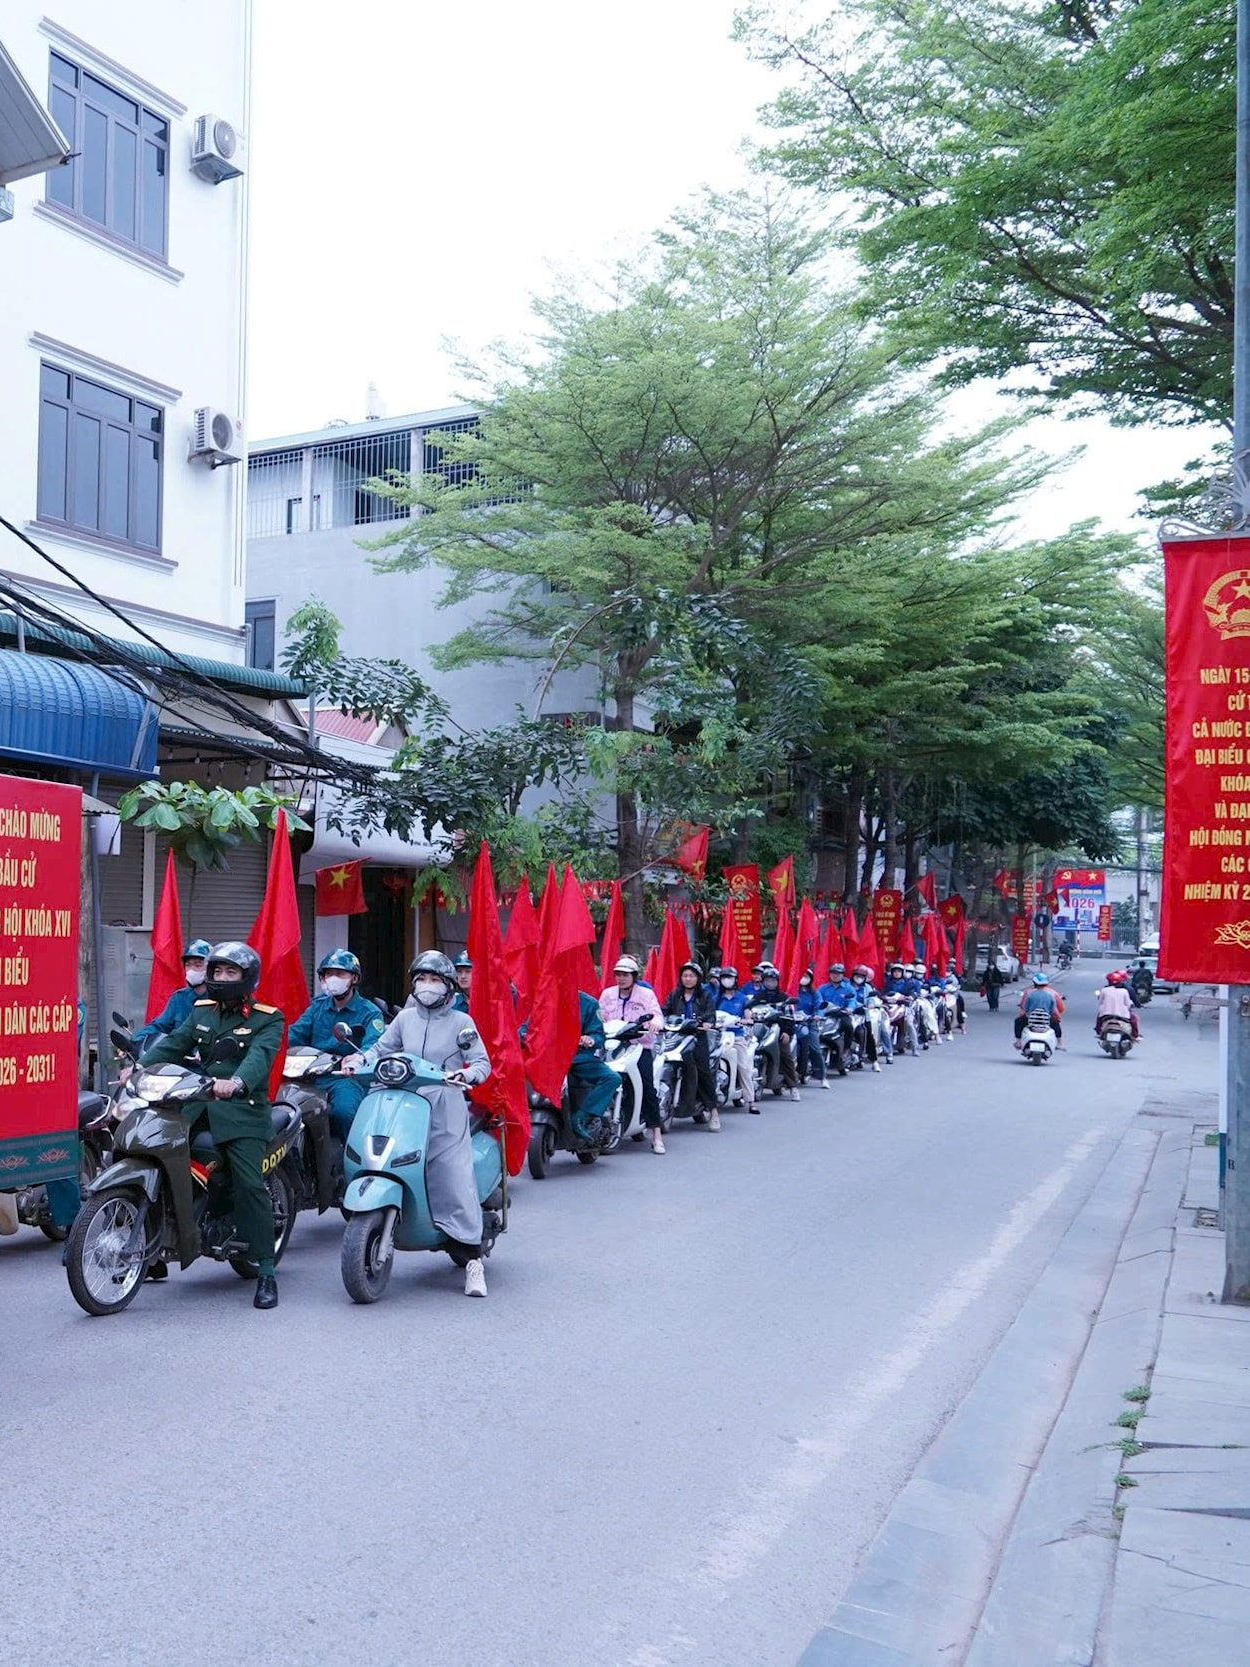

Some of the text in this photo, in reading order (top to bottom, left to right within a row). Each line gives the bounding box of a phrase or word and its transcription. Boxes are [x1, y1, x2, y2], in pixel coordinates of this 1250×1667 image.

[1200, 664, 1231, 684] NGÀY
[1228, 690, 1246, 710] CỬ
[1192, 717, 1209, 738] CẢ
[1211, 719, 1242, 737] NƯỚC
[1195, 749, 1216, 768] ĐẠI
[1218, 742, 1243, 765] BIỂU
[1214, 799, 1227, 818] VÀ
[30, 808, 61, 842] MỪNG
[1189, 826, 1209, 848] HỘI
[21, 851, 37, 888] CỬ
[1221, 853, 1245, 873] CÁC
[1184, 880, 1222, 902] NHIỆM
[1223, 880, 1239, 900] KỲ
[3, 902, 22, 942] HỘI
[25, 904, 52, 937] KHÓA
[54, 910, 71, 938] XVI
[4, 945, 29, 986] BIỂU
[4, 1000, 27, 1035] DÂN
[29, 1000, 50, 1034] CÁC
[52, 995, 73, 1033] CẤP
[26, 1053, 56, 1084] 2031!
